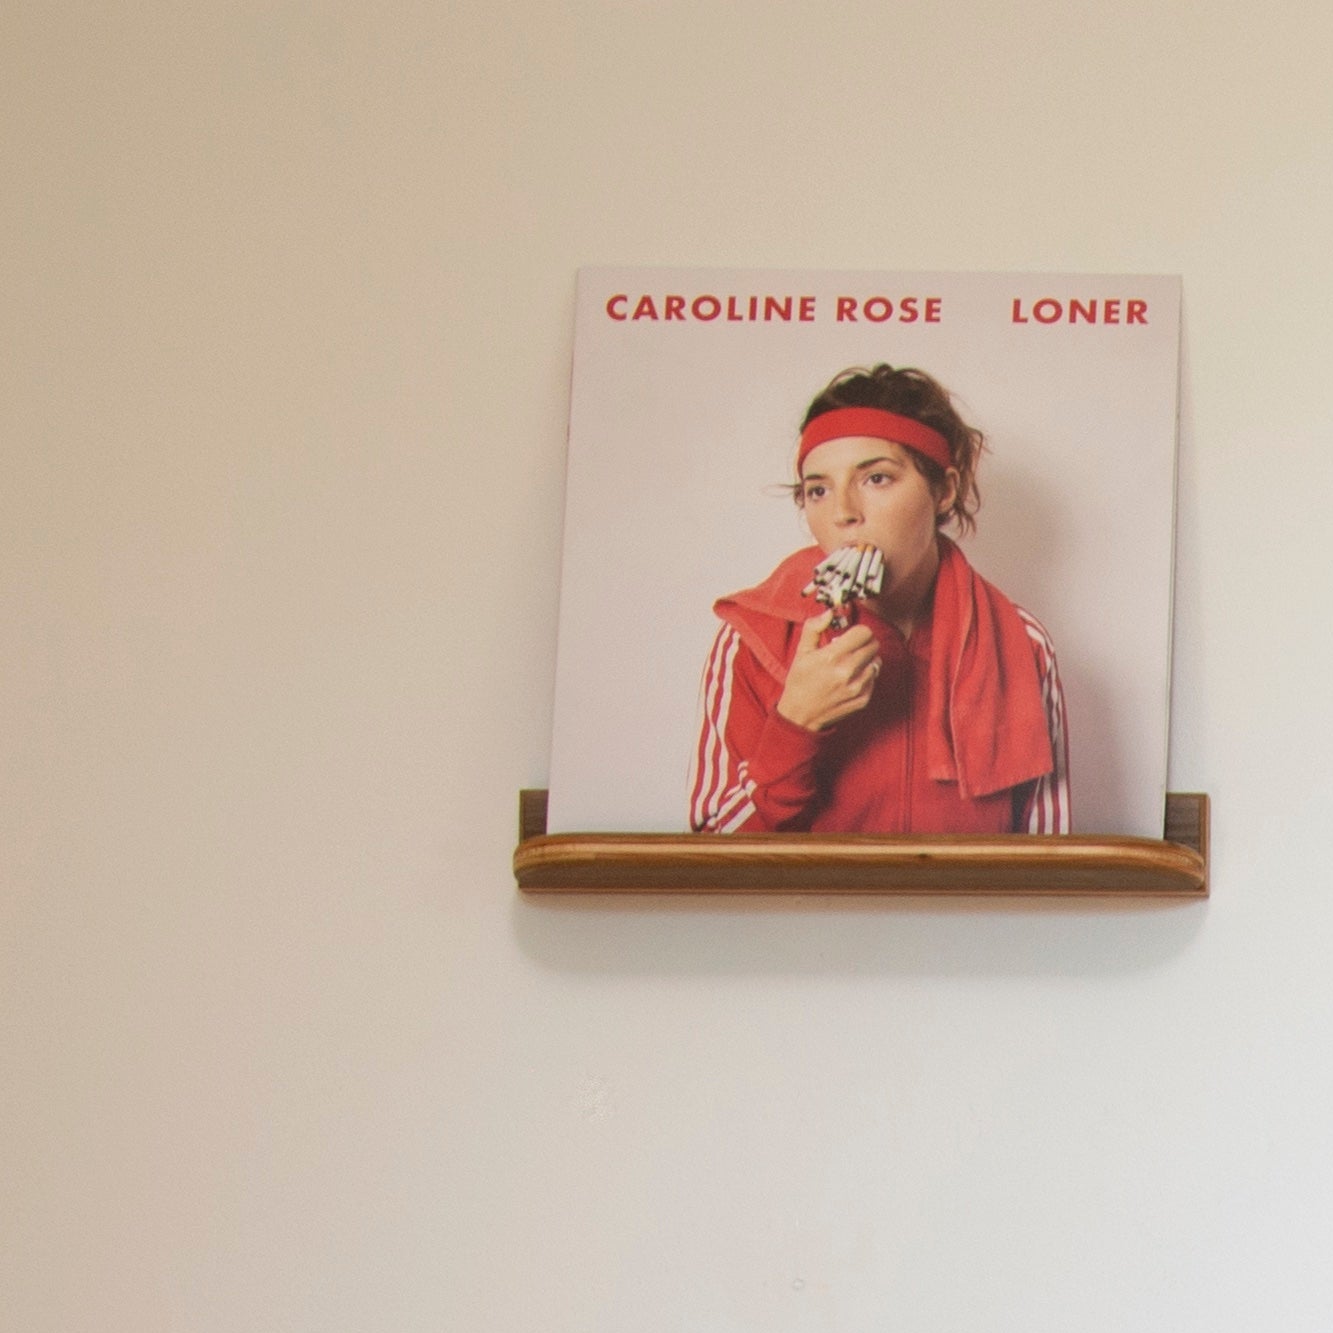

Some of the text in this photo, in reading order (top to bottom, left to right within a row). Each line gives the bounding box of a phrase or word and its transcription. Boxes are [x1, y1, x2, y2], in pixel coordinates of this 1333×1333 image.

[605, 294, 943, 324] CAROLINE ROSE
[1012, 298, 1149, 325] LONER
